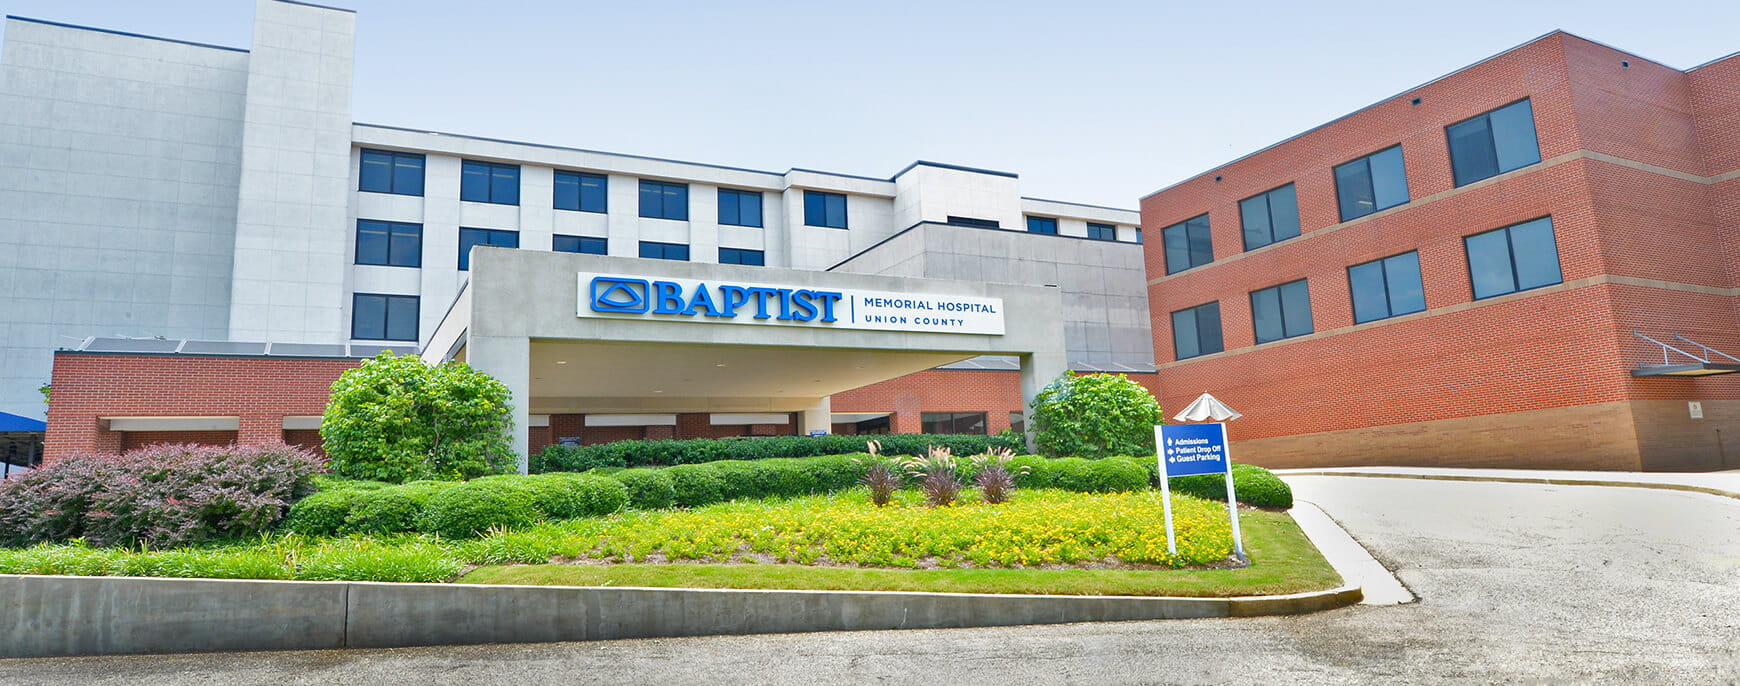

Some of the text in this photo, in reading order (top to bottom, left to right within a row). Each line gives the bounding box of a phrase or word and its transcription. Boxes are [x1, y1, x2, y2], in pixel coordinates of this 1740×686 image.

[652, 280, 843, 323] BAPTIST
[864, 297, 997, 314] MEMORIAL HOSPITAL
[864, 314, 965, 327] UNION COUNTY
[1175, 446, 1196, 454] Patient
[1197, 453, 1220, 461] Parking
